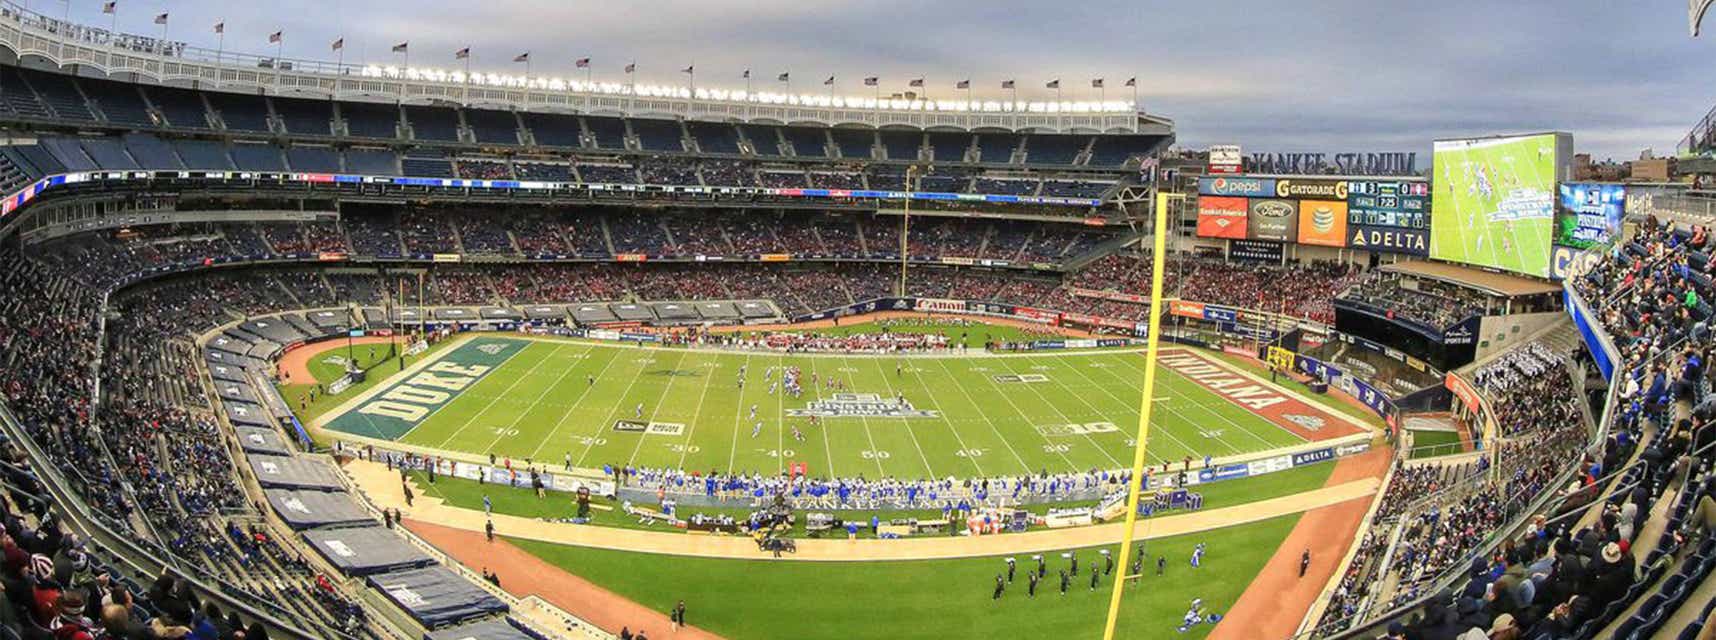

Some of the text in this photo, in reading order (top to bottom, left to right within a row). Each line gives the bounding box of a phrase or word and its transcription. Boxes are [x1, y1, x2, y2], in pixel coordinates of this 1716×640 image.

[1253, 152, 1326, 174] YANKEE
[1335, 152, 1417, 175] STADIUM
[1230, 180, 1262, 193] pepsi
[1290, 185, 1335, 195] GATORADE
[1261, 204, 1286, 218] Ford
[1371, 231, 1425, 249] DELTA
[916, 299, 966, 311] Canon
[1155, 353, 1288, 410] INDIANA
[358, 361, 491, 422] DUKE
[767, 449, 795, 458] 40
[861, 451, 891, 459] 50
[1304, 449, 1330, 461] DELTA
